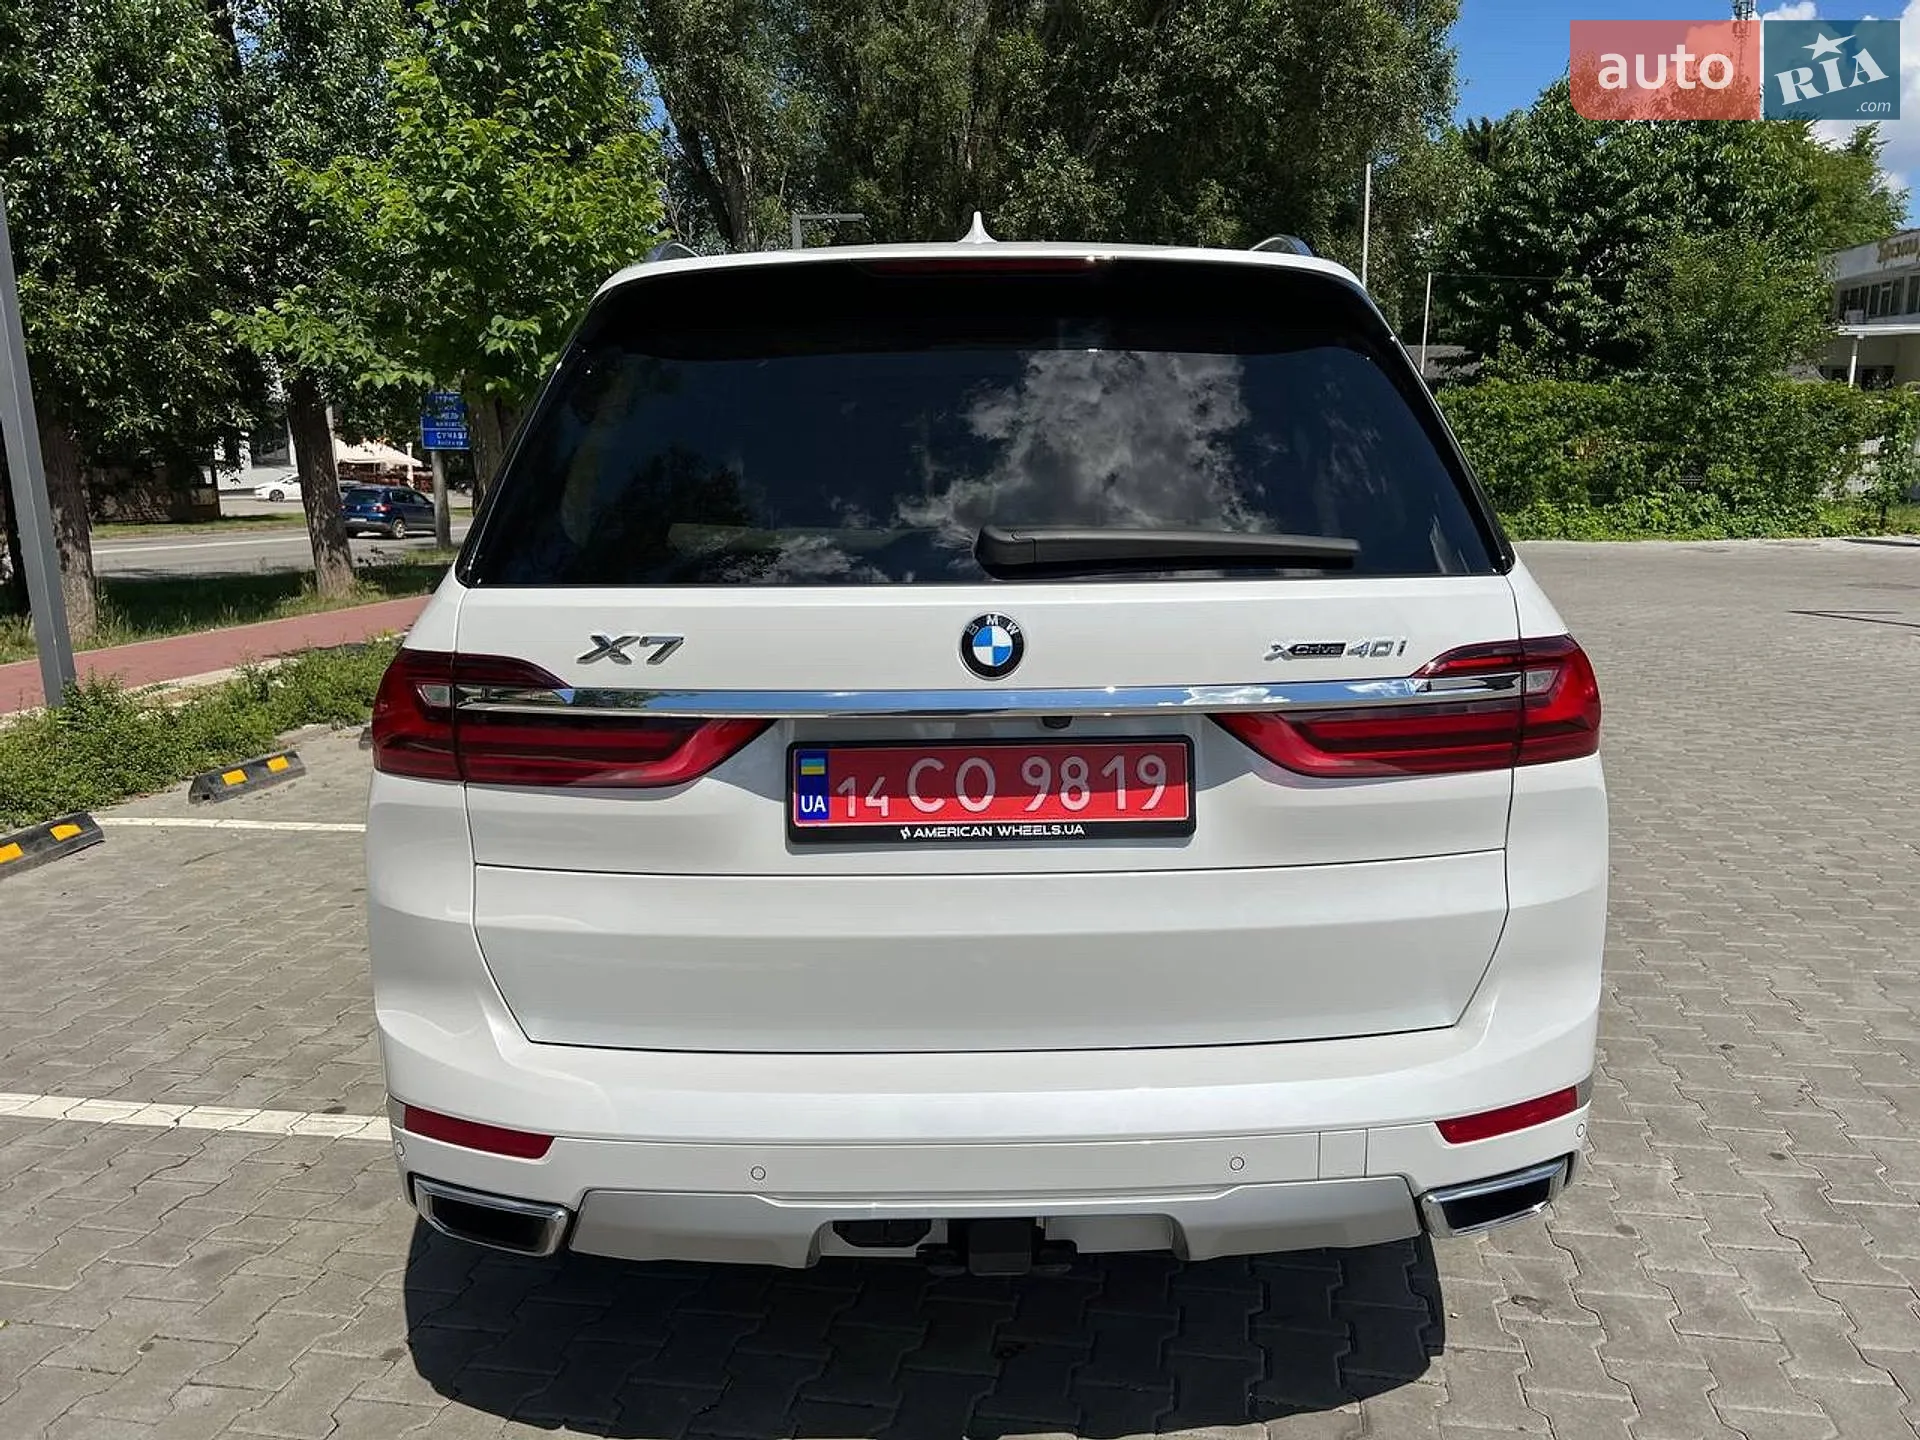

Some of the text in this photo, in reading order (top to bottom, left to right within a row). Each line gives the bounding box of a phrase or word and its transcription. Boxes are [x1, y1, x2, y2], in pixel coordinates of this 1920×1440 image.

[966, 614, 1020, 636] BMW
[576, 635, 684, 665] X7
[837, 754, 1168, 818] 14 CO 9819
[801, 795, 826, 813] UA
[913, 824, 1085, 838] AMERICAN WHEELS.UA
